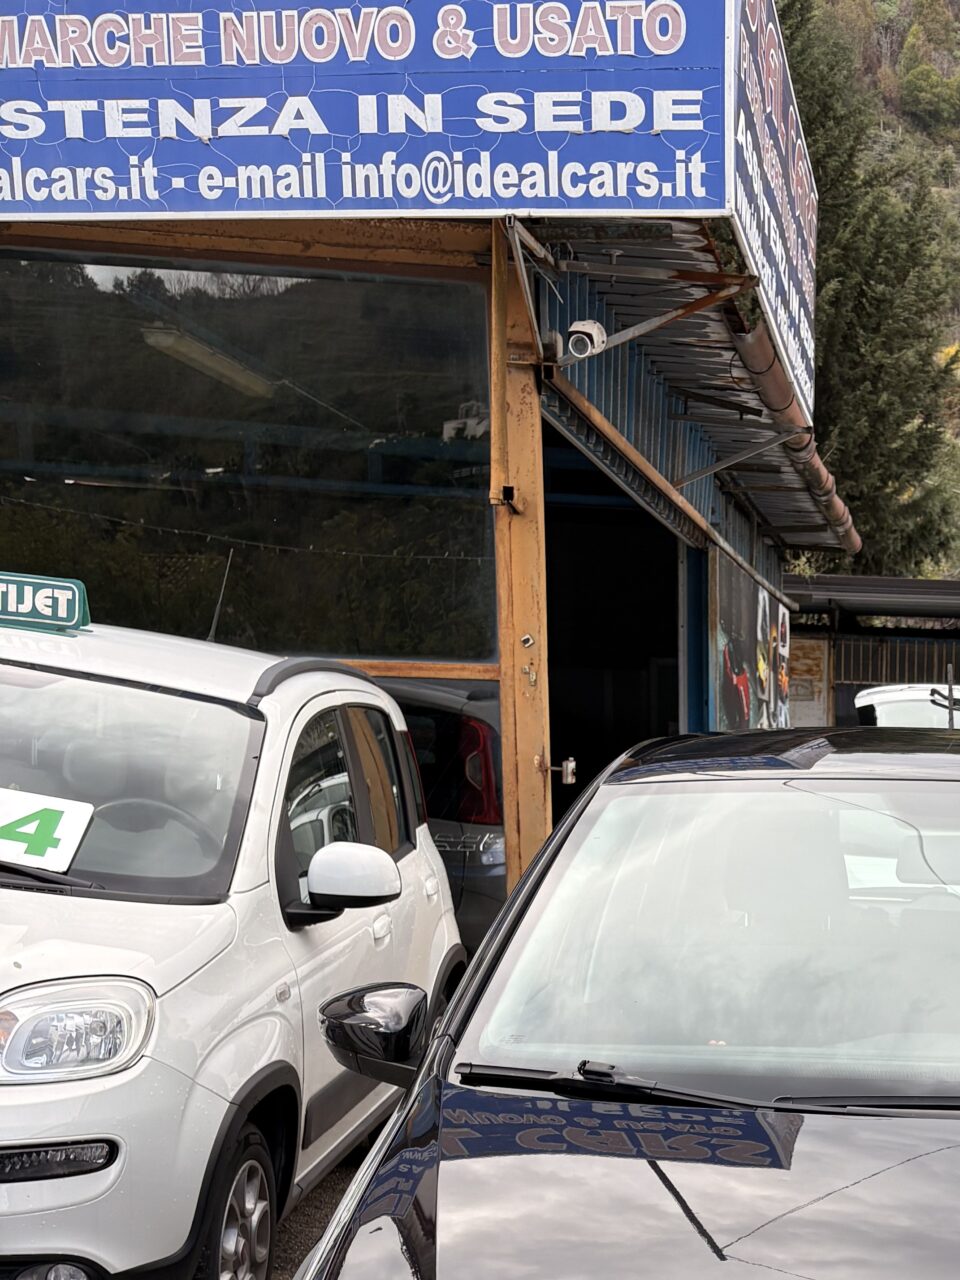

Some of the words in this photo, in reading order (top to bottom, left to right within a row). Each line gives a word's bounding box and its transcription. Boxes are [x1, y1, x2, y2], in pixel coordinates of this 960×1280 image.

[219, 6, 416, 66] NUOVO
[433, 4, 478, 59] &
[493, 0, 686, 58] USATO
[0, 95, 329, 139] STENZA
[358, 94, 443, 133] IN
[475, 90, 704, 132] SEDE
[198, 152, 325, 200] e-mail
[341, 150, 706, 204] info@idealcars.it
[0, 807, 65, 857] 4
